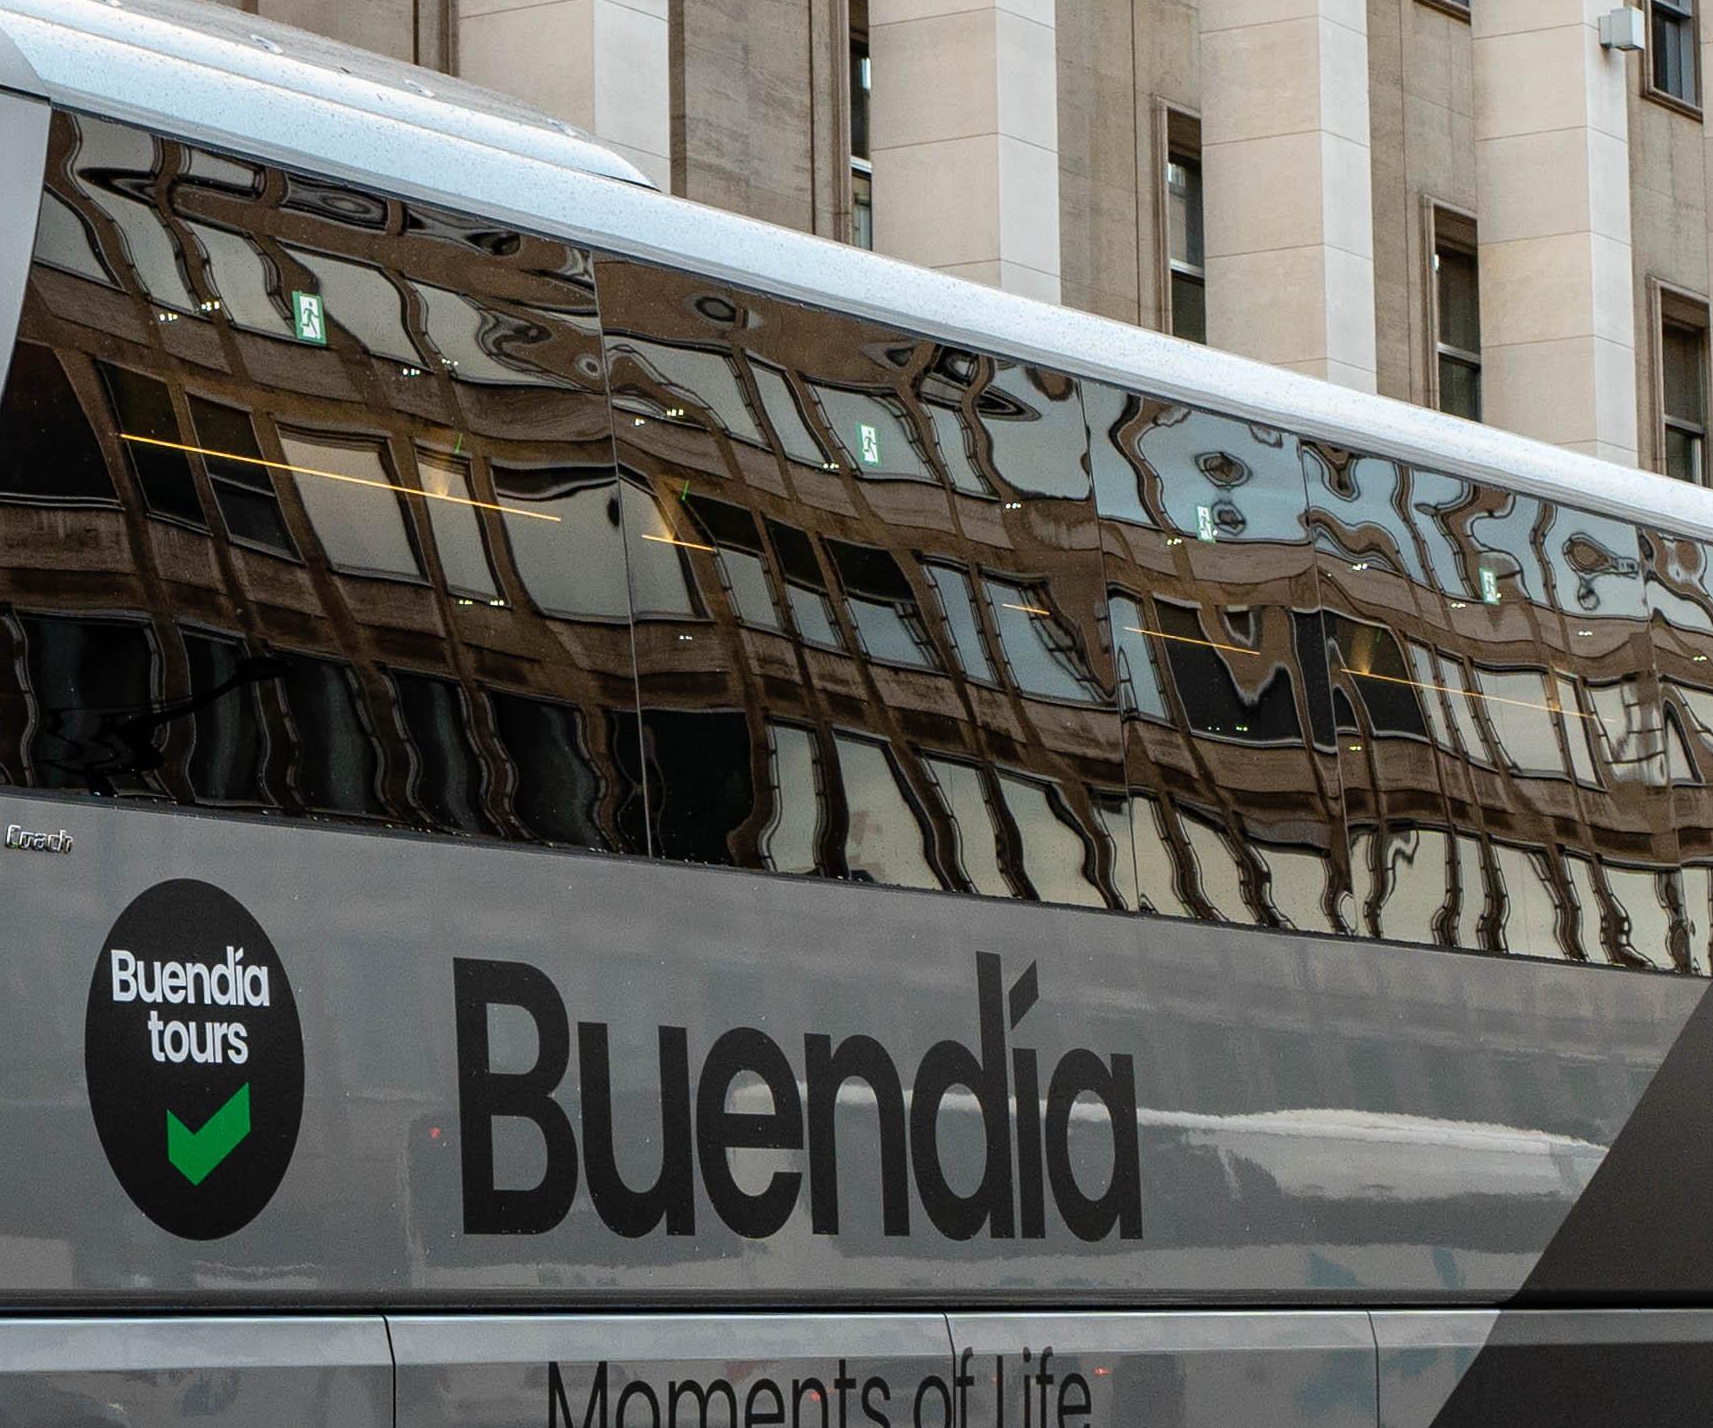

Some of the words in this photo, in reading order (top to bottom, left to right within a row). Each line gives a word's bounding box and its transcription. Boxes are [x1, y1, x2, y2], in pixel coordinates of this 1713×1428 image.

[5, 824, 73, 854] Coach
[111, 946, 270, 1010] Buendía
[148, 1008, 249, 1066] tours
[453, 950, 1144, 1242] Buendía
